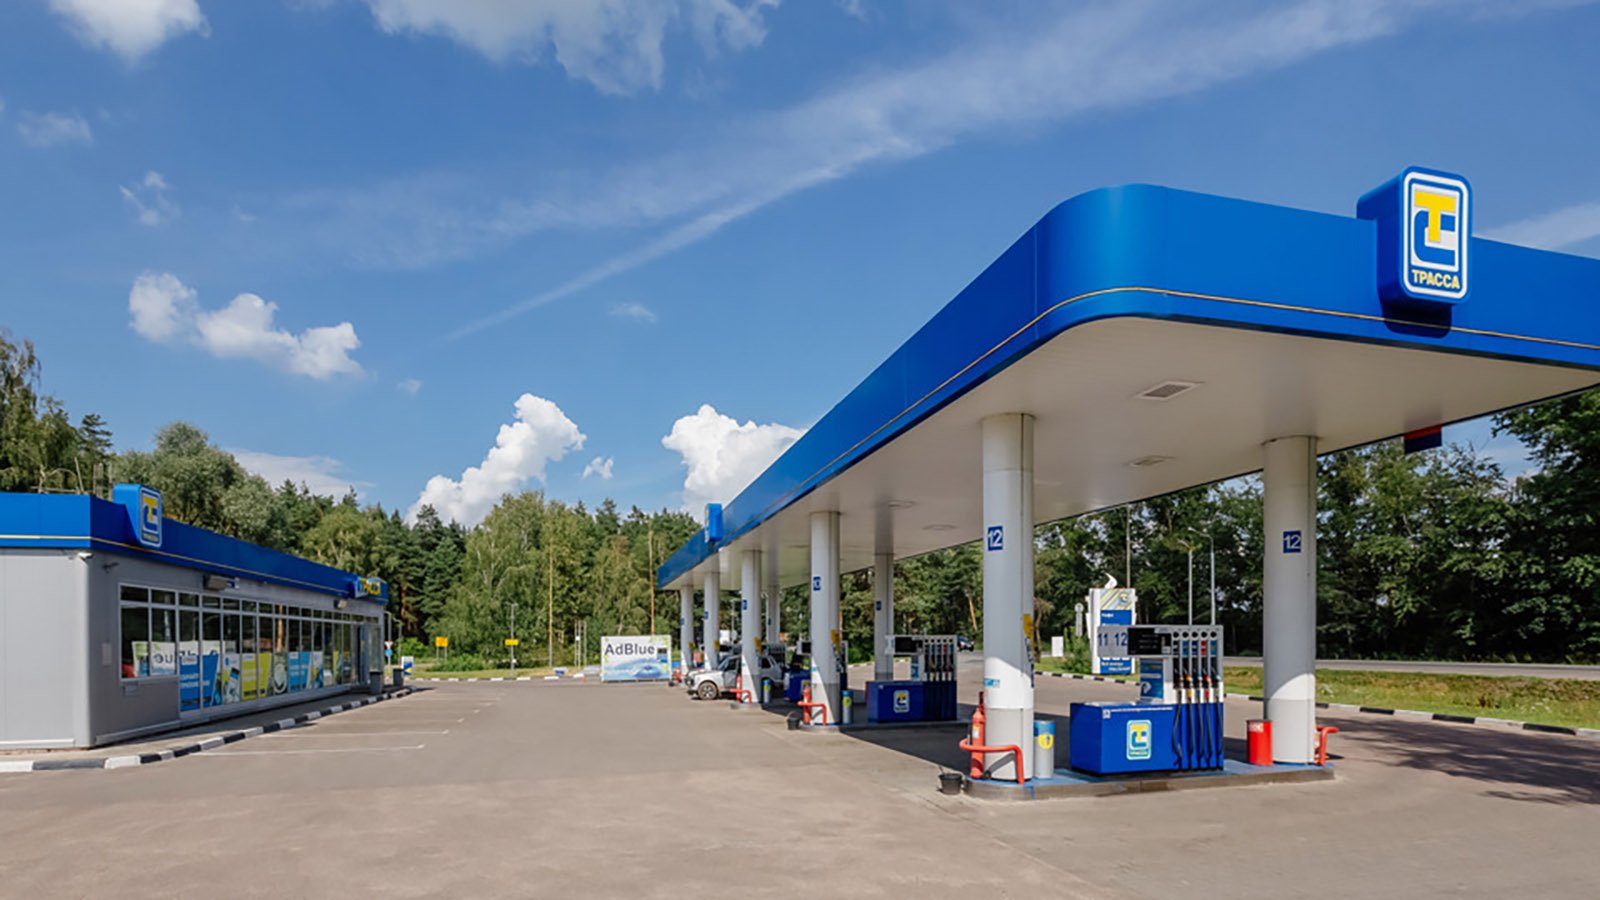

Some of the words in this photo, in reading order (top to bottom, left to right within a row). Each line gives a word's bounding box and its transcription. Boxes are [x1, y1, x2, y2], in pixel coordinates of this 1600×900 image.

[1411, 269, 1460, 289] ТРАССА
[987, 529, 1002, 547] 12
[1283, 534, 1301, 549] 12
[1097, 632, 1108, 646] 11
[1115, 632, 1128, 646] 12
[604, 643, 655, 656] AdBlue
